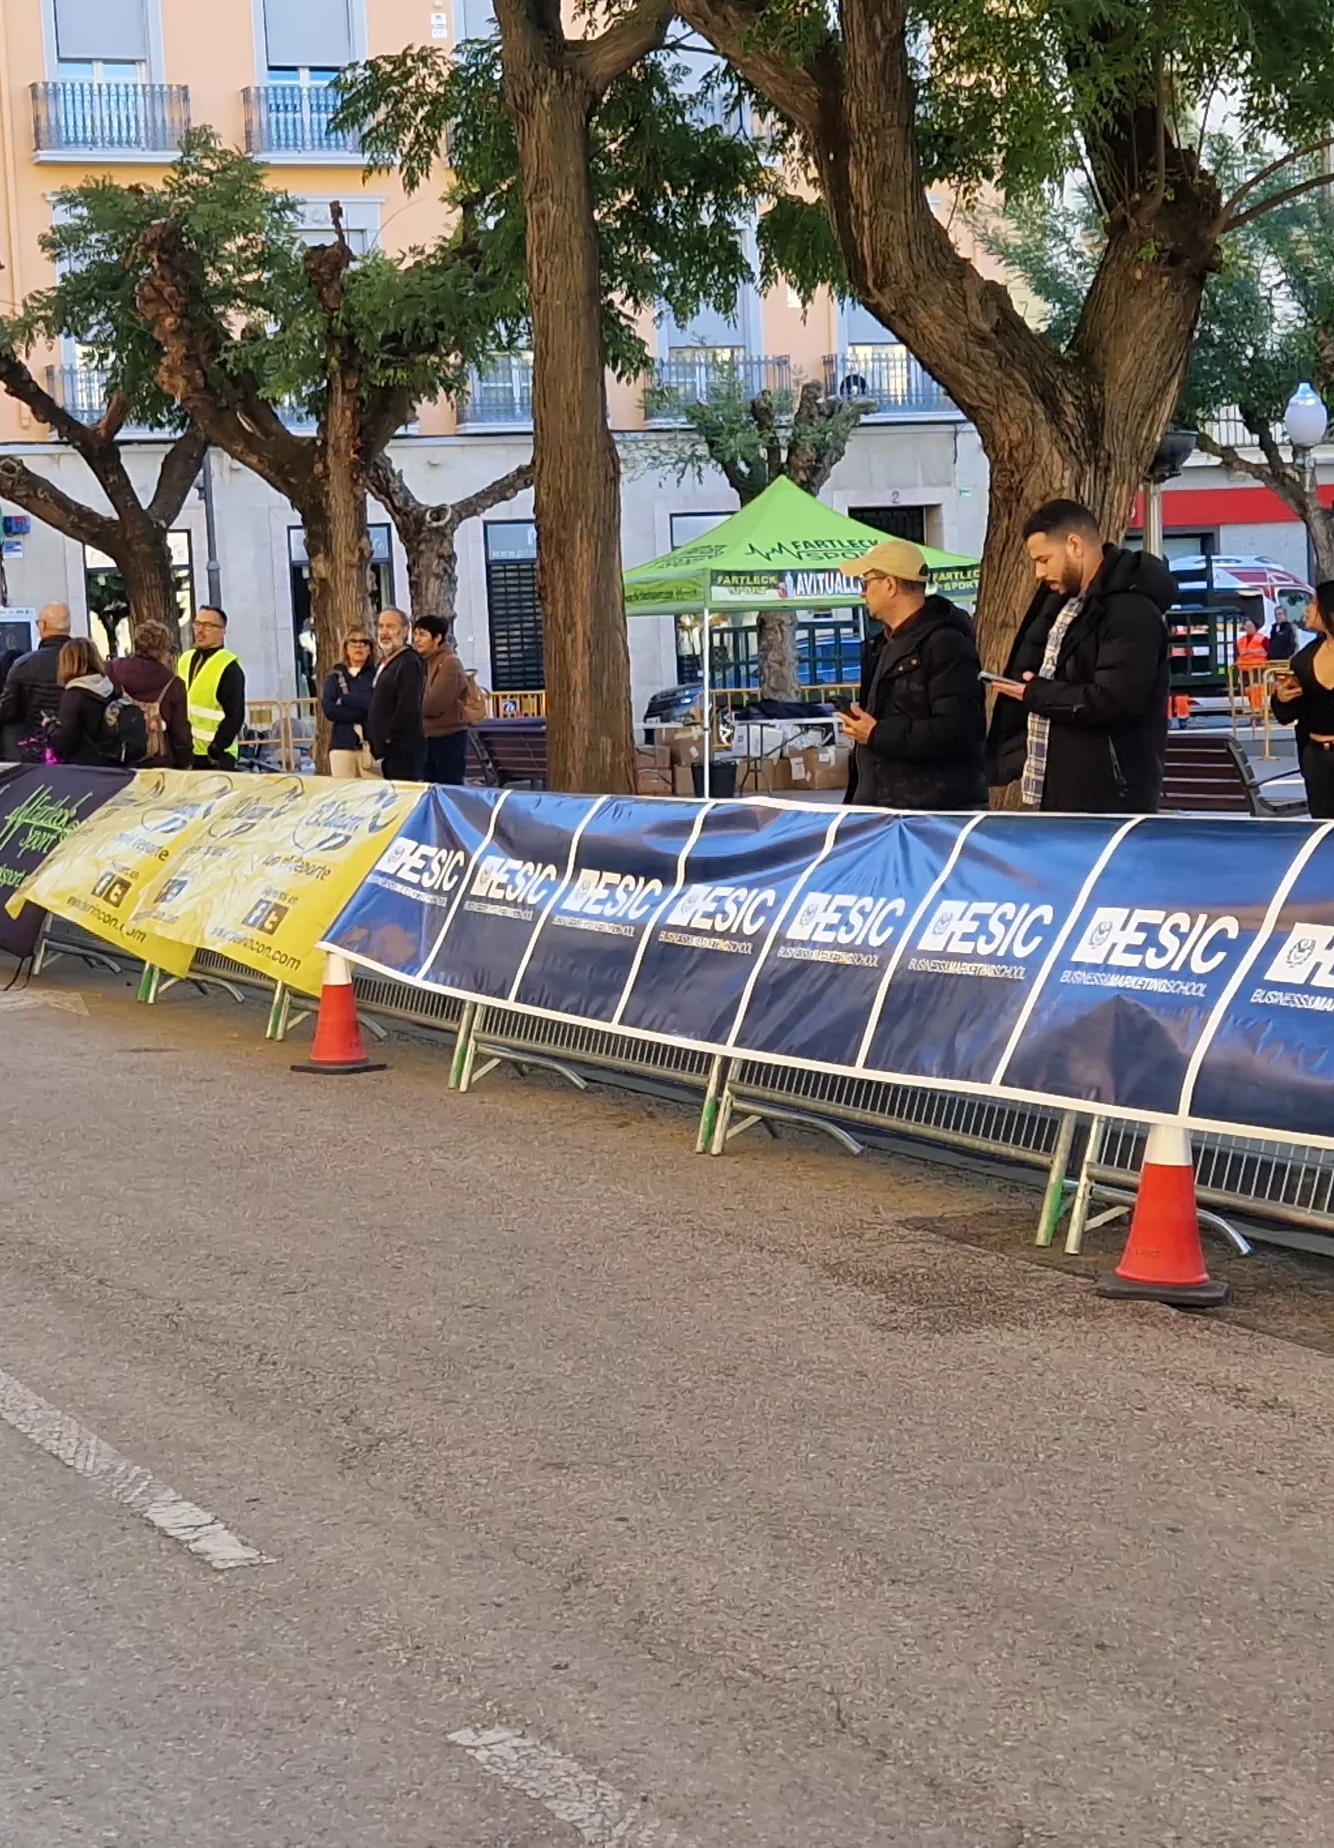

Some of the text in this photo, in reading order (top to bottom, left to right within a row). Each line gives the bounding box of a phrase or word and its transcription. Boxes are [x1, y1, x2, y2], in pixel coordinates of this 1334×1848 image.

[892, 490, 901, 504] 2
[806, 552, 865, 561] SPO
[397, 844, 465, 892] ESIC
[488, 858, 557, 905] ESIC
[582, 871, 663, 920] ESIC
[690, 886, 776, 936] ESIC
[811, 894, 906, 947] ESIC
[947, 902, 1054, 958] ESIC
[1107, 910, 1239, 974] ESIC
[1060, 970, 1208, 997] BUSINESS&MARKETINGSCHOOL
